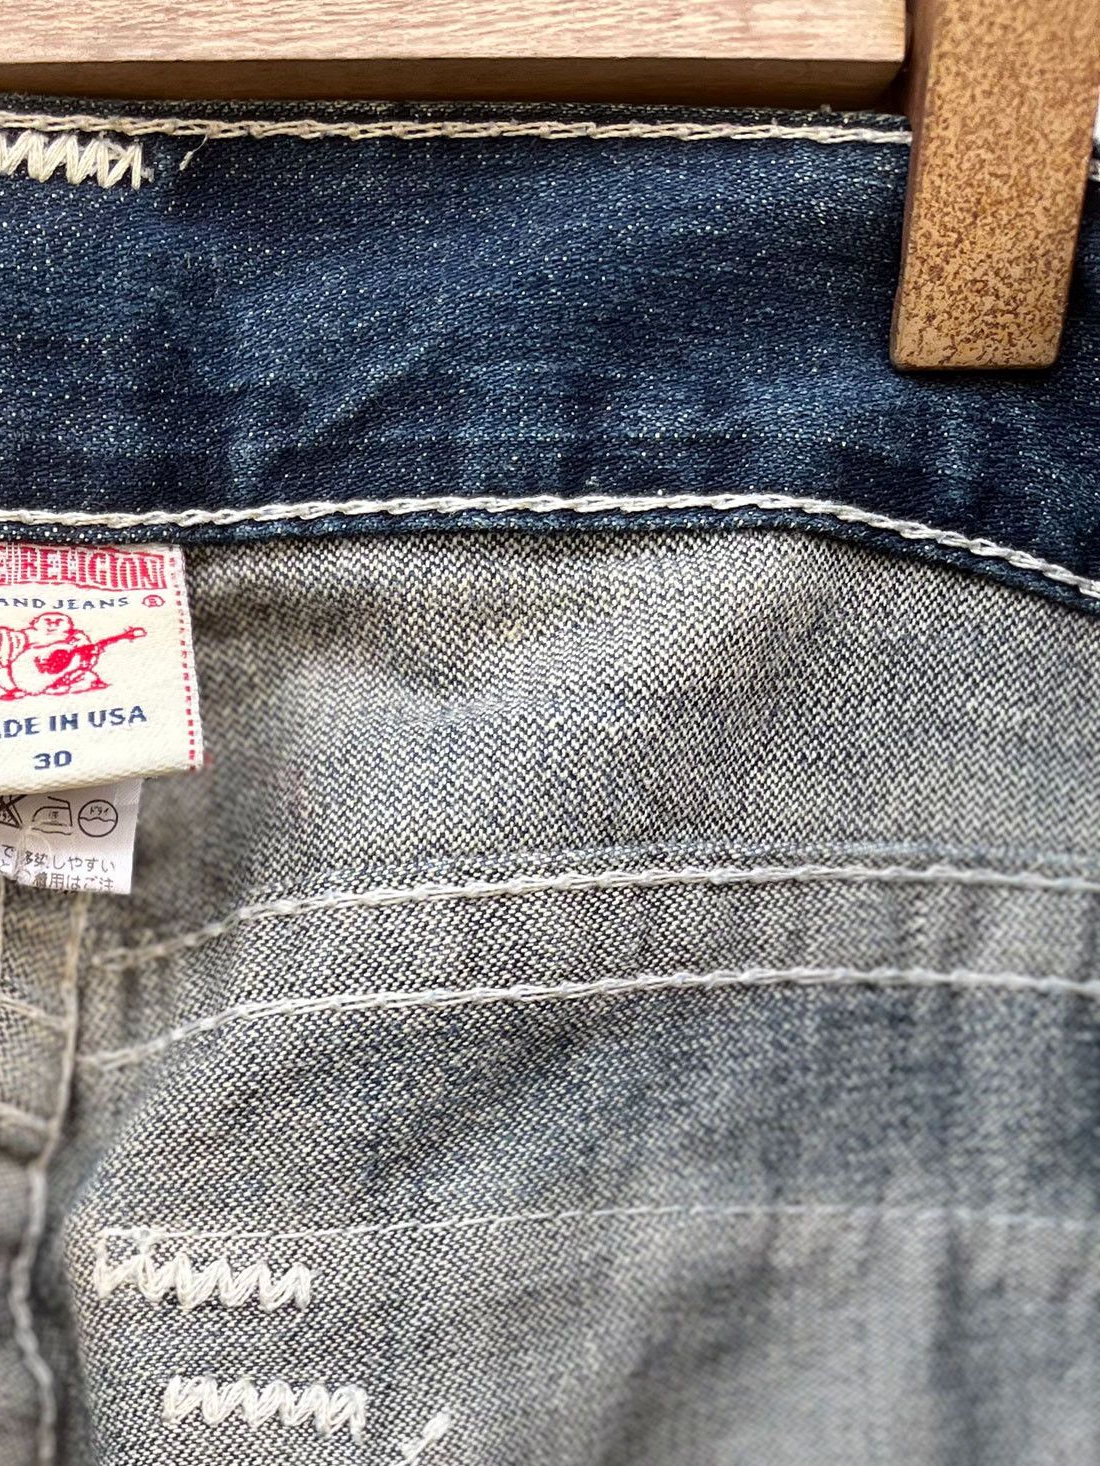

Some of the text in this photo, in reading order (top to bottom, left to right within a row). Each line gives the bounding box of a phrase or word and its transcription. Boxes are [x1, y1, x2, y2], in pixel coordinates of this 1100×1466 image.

[19, 545, 164, 590] RELIGION
[53, 596, 130, 610] JEANS
[49, 713, 78, 732] IN
[88, 705, 147, 728] USA
[32, 750, 72, 770] 30
